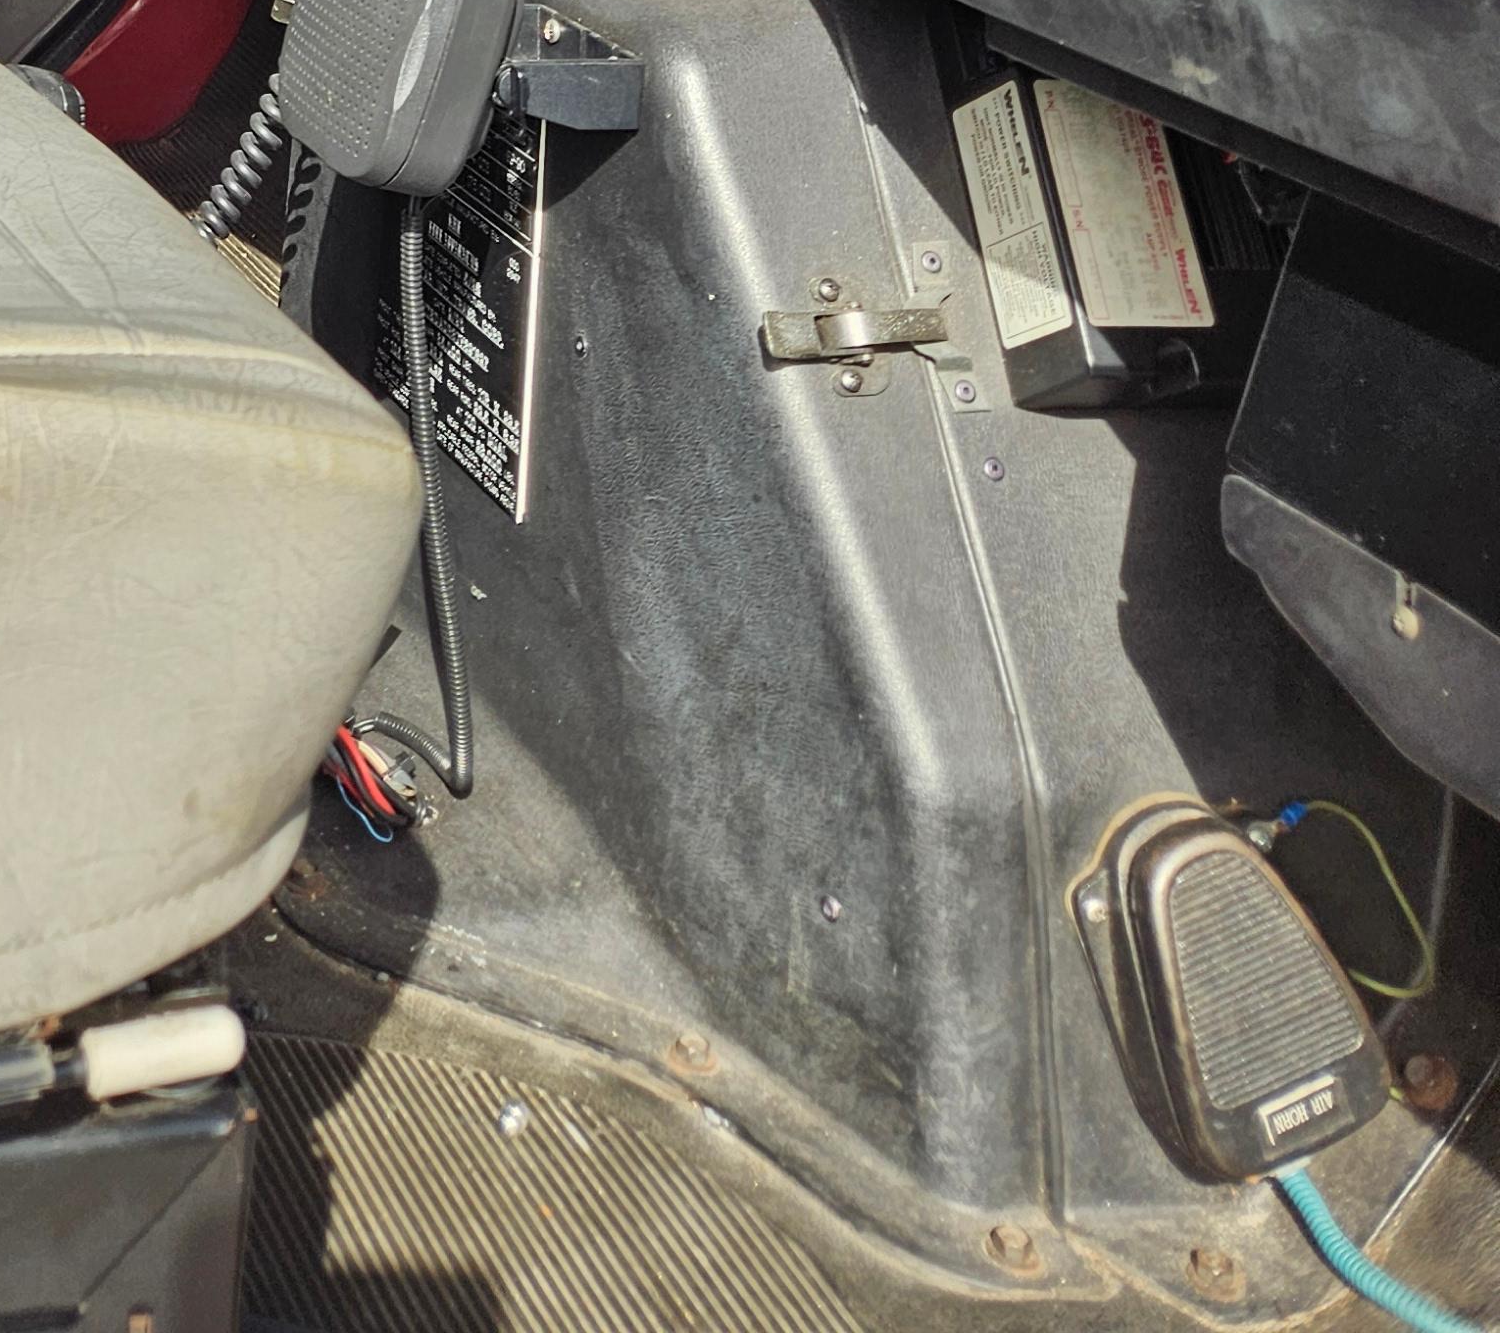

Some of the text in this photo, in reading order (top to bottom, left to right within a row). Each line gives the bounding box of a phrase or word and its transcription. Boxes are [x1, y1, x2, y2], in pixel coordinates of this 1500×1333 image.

[1004, 89, 1029, 176] WHELEN
[1176, 248, 1201, 313] WHELEN
[1273, 1090, 1333, 1134] AIR HORN
